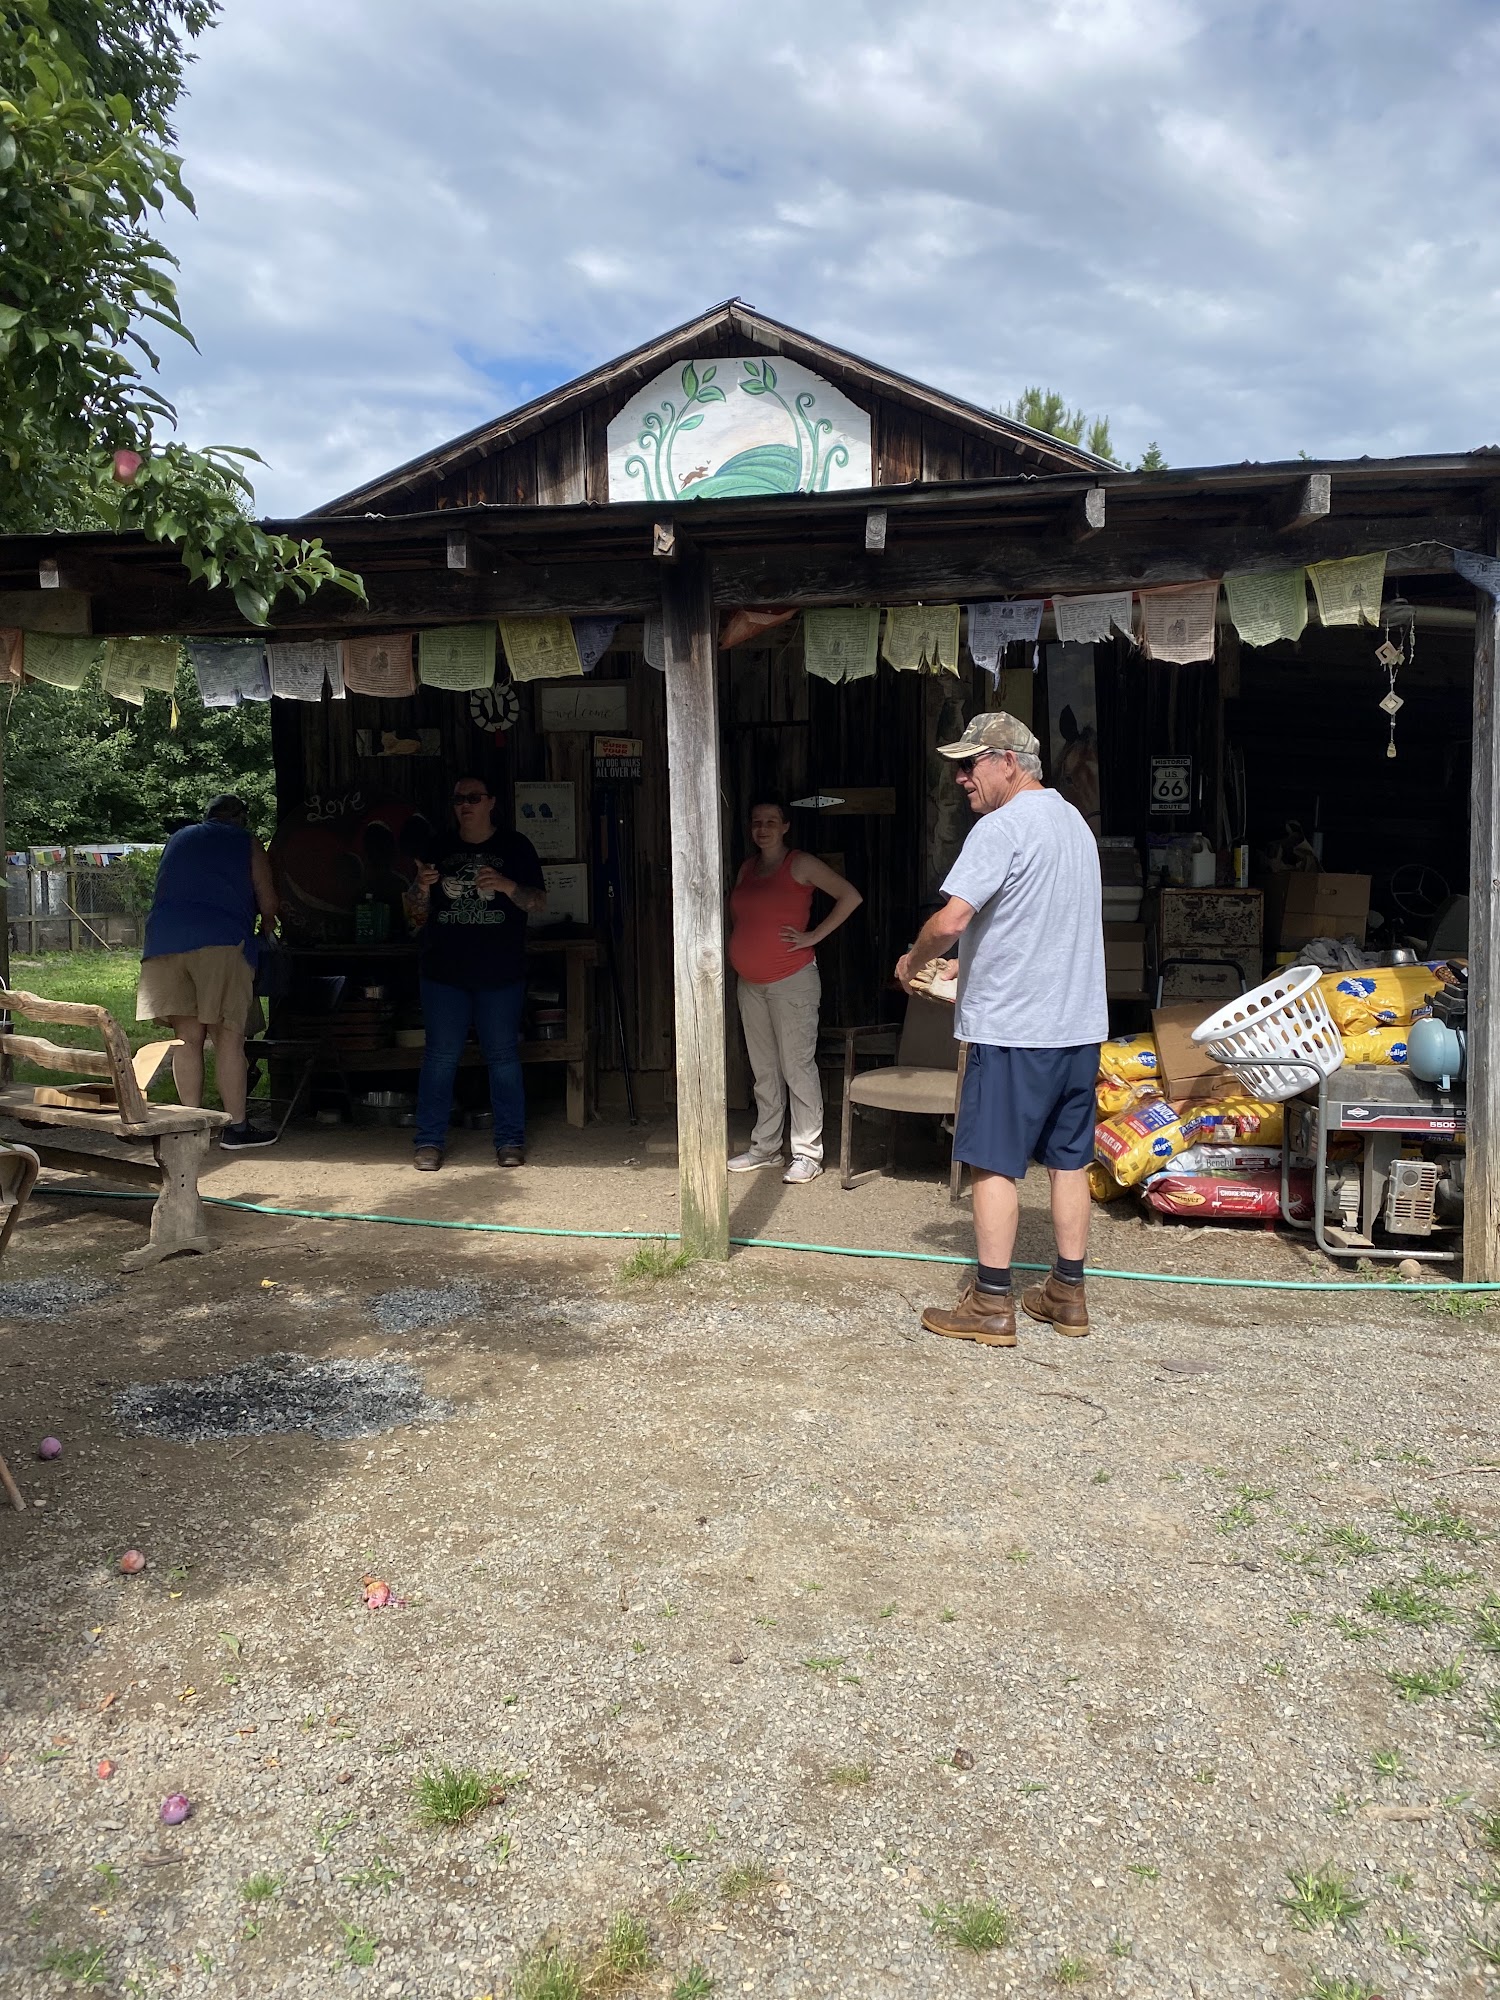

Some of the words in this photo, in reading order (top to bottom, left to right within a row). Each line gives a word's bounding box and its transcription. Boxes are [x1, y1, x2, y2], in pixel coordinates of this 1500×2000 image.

[595, 758, 605, 767] MY
[606, 758, 619, 767] DOG
[620, 758, 641, 767] WALKS
[596, 767, 608, 777] ALL
[610, 767, 629, 777] OVER
[630, 767, 641, 777] ME
[1158, 780, 1183, 797] 66
[304, 790, 366, 822] Love
[450, 897, 488, 912] 420
[437, 909, 506, 925] STONED
[1429, 1121, 1457, 1129] 5500
[1206, 1157, 1234, 1168] Beneful
